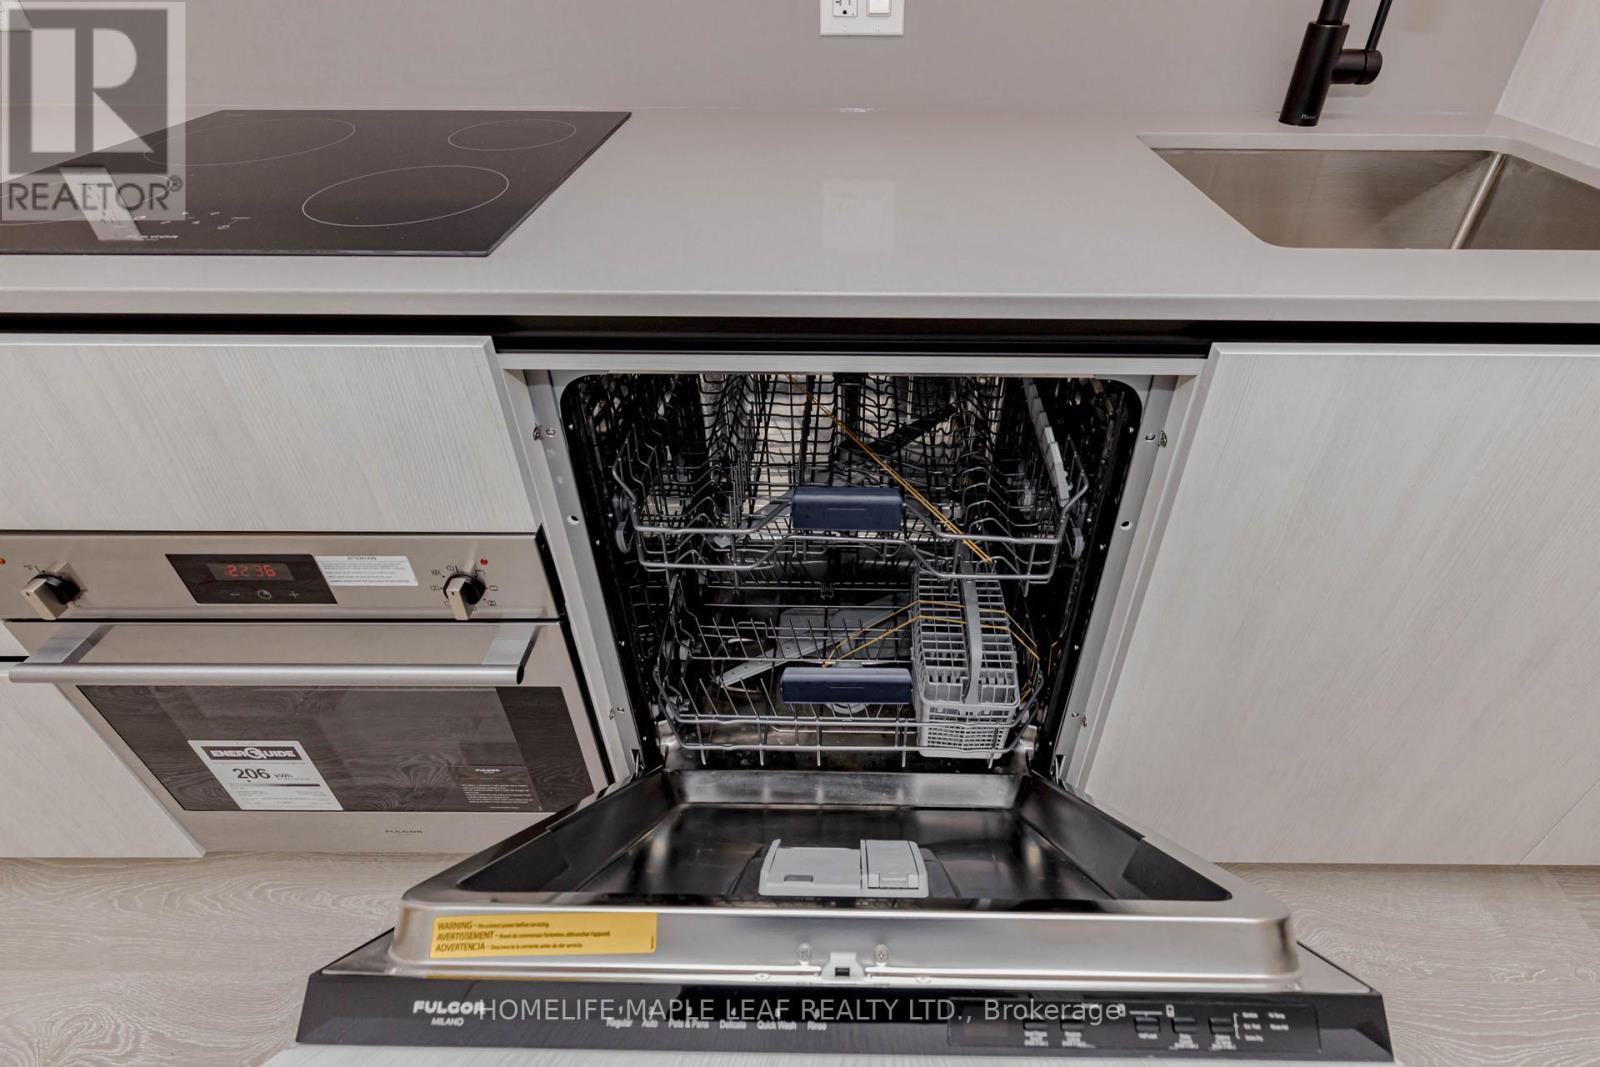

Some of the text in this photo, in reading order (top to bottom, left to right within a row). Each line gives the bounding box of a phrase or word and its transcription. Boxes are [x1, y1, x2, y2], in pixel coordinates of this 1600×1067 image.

[233, 768, 271, 779] 206
[437, 921, 473, 930] WARNING
[436, 931, 494, 941] AVERTISSEMENT
[435, 942, 485, 953] ADVERTENCIA
[431, 1017, 465, 1026] MILANO
